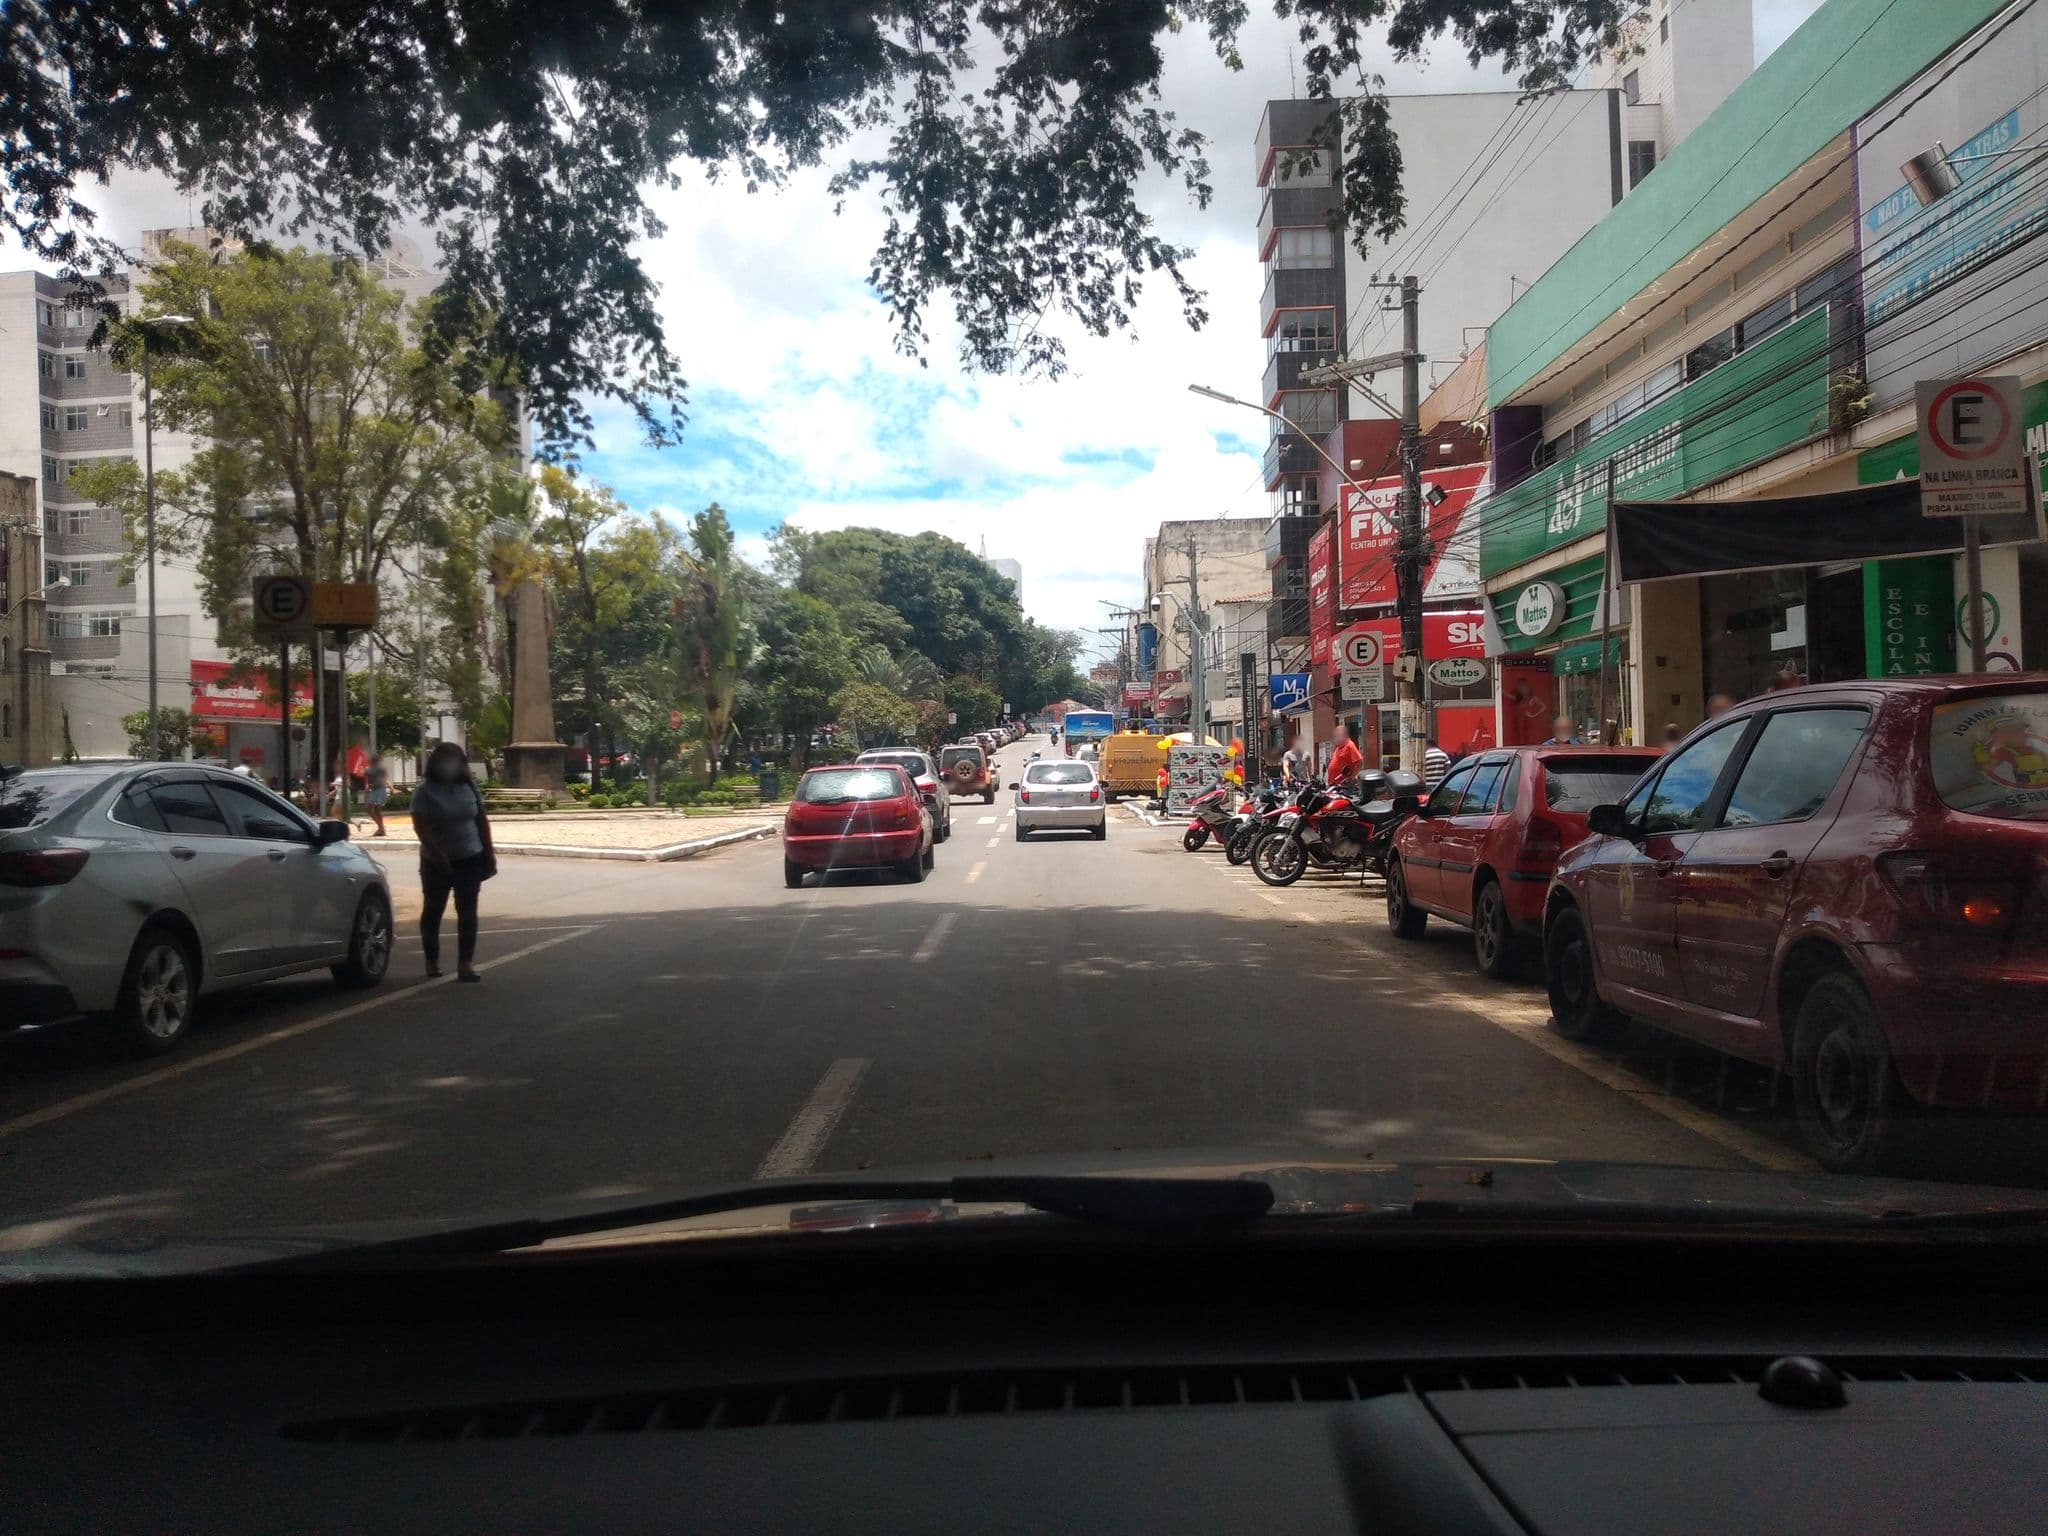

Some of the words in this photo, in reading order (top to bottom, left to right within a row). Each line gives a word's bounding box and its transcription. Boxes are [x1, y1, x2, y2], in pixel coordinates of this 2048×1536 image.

[1952, 396, 1984, 445] E
[1592, 419, 1682, 496] MIROCAMP
[1925, 471, 1940, 483] NA
[1942, 469, 1973, 483] LINHA
[1975, 468, 2018, 481] BRANCA
[1926, 504, 1952, 513] PISCA
[1351, 539, 1377, 550] CENTRO
[272, 587, 293, 614] E
[1522, 605, 1548, 625] Mattos
[1886, 588, 1904, 674] ESCOLA
[1356, 642, 1368, 660] E
[1440, 669, 1480, 678] Mattos
[1245, 673, 1253, 718] Guadalupe
[1247, 722, 1256, 758] Travessa
